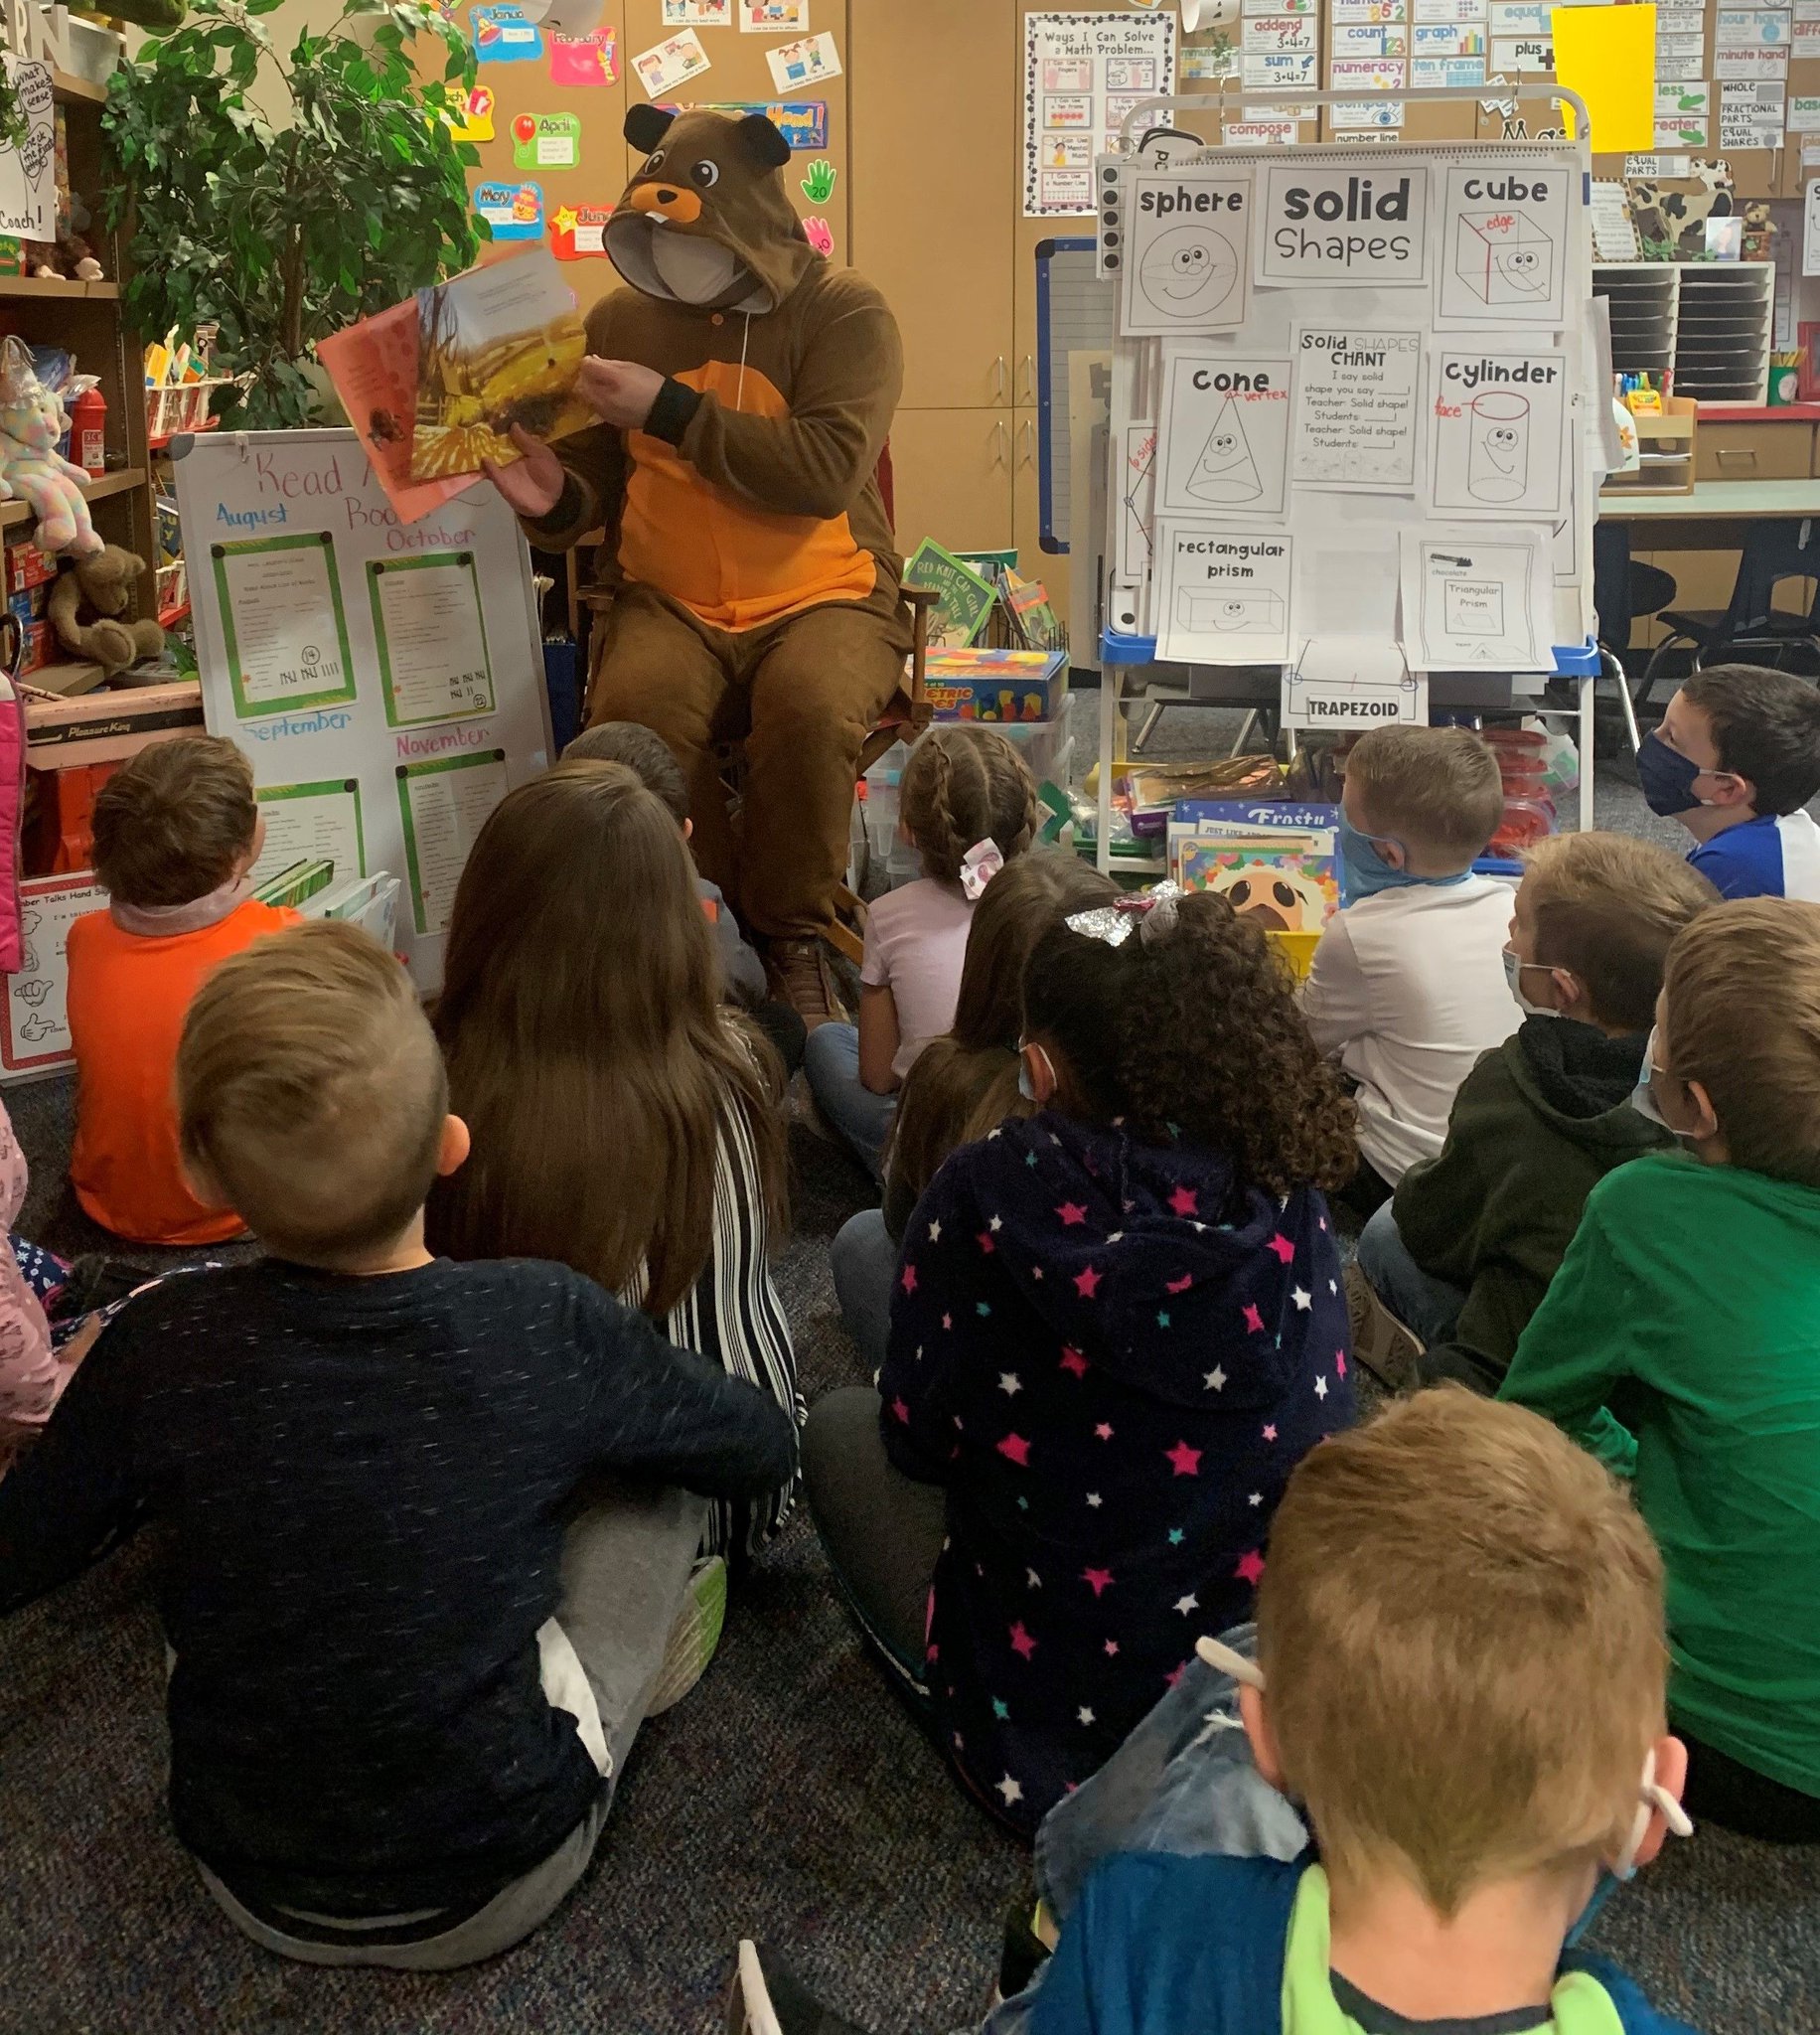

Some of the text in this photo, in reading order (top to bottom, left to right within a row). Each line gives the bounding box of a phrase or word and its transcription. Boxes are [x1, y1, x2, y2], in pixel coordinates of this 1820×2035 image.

[490, 8, 525, 21] Janua
[1395, 5, 1405, 20] 2
[1504, 6, 1542, 19] equal
[1719, 12, 1789, 25] hour hand
[1255, 19, 1302, 32] addend
[1348, 26, 1387, 39] count
[1045, 32, 1155, 45] Ways I Can Solve
[1416, 25, 1457, 41] graph
[1065, 45, 1093, 56] Math
[1515, 42, 1542, 57] plus
[1717, 49, 1786, 60] minute hand
[1265, 56, 1293, 67] sum
[1415, 59, 1484, 71] ten frame
[1333, 63, 1404, 75] numeracy
[1658, 82, 1685, 96] less
[1722, 103, 1777, 113] FRACTIONAL
[1653, 119, 1700, 131] reater
[1721, 114, 1752, 123] PARTS
[539, 118, 570, 134] April
[1229, 123, 1291, 137] compose
[1380, 133, 1398, 142] line
[1625, 166, 1657, 176] PARTS
[812, 186, 828, 199] 20
[1464, 176, 1549, 202] cube
[481, 188, 511, 206] May
[1140, 186, 1243, 218] sphere
[1285, 177, 1411, 222] solid
[579, 208, 611, 223] Jun
[1486, 214, 1515, 234] edge
[1275, 228, 1411, 266] Shapes
[1301, 335, 1420, 353] Solid SHAPES
[1331, 352, 1386, 367] CHANT
[1332, 371, 1384, 382] I say solid
[1445, 359, 1558, 389] cylinder
[1244, 390, 1288, 401] vertex
[1304, 384, 1375, 396] shape you say
[1351, 397, 1374, 408] Solid
[1435, 395, 1462, 417] face
[1349, 425, 1372, 435] Solid
[256, 452, 343, 499] Read
[217, 502, 290, 532] August
[386, 526, 476, 551] October
[1177, 541, 1287, 559] rectangular
[917, 561, 934, 573] RED
[936, 563, 957, 580] KNIT
[1207, 563, 1254, 579] prism
[1448, 584, 1499, 596] Triangular
[1459, 598, 1488, 608] Prism
[304, 649, 317, 663] 14
[475, 697, 486, 706] 22
[1309, 700, 1399, 716] TRAPEZOID
[396, 726, 490, 758] November
[44, 895, 67, 904] Talks
[70, 890, 91, 900] Hand
